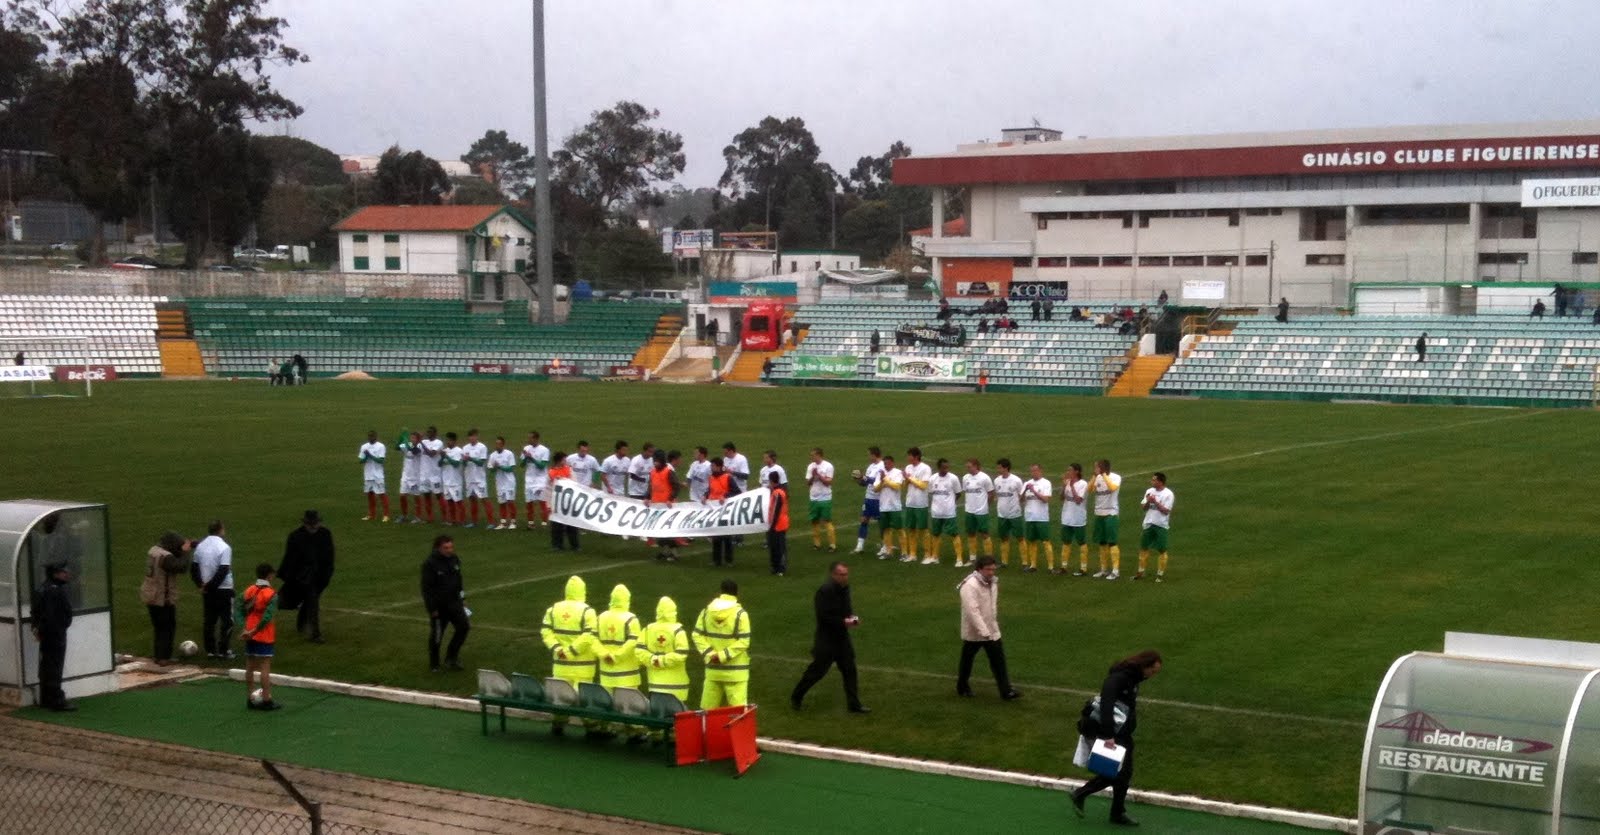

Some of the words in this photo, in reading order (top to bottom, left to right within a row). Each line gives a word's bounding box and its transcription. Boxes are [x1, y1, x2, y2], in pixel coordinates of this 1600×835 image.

[1302, 148, 1387, 167] GINÁSIO
[1394, 149, 1455, 164] CLUBE
[1462, 144, 1600, 162] FIGUEIRENSE
[554, 485, 618, 523] TODOS
[618, 505, 664, 530] COM
[660, 509, 682, 530] A
[677, 495, 765, 530] MADEIRA
[1378, 749, 1545, 782] RESTAURANTE
